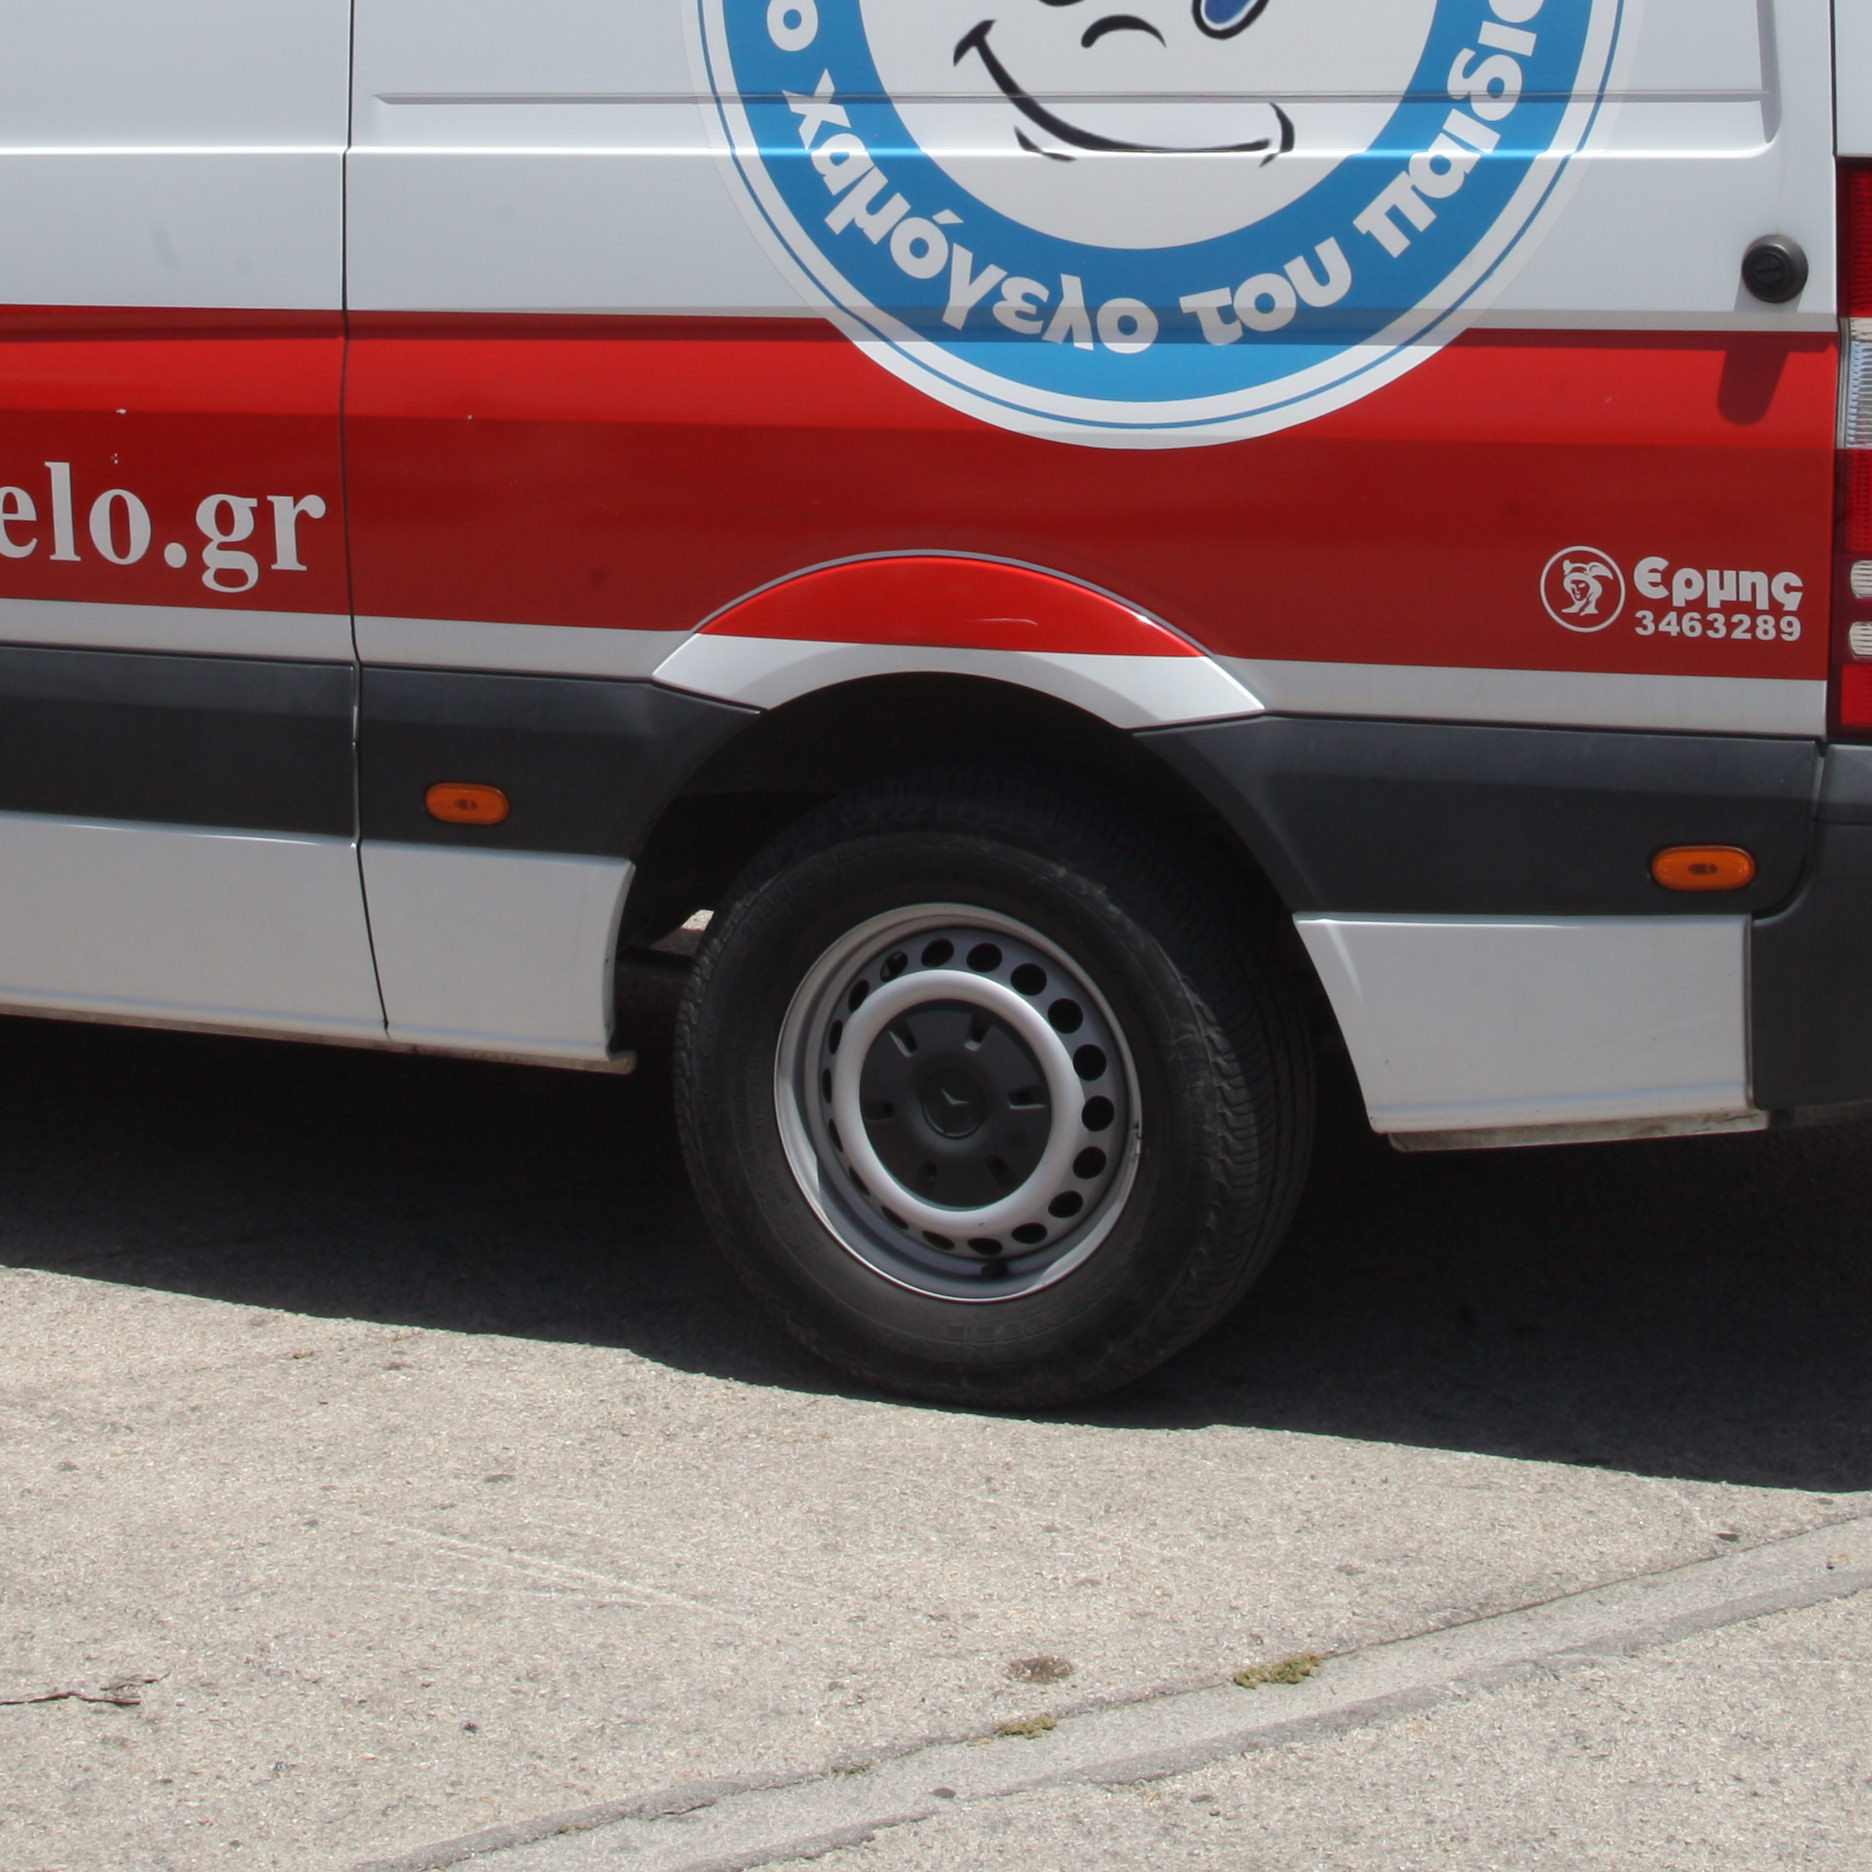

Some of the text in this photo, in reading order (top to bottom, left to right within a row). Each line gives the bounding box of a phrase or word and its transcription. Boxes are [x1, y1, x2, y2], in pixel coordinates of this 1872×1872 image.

[781, 67, 1159, 354] χαμόγελο
[1180, 235, 1353, 347] του
[1632, 555, 1804, 611] Ερμης
[1633, 609, 1802, 641] 3463289
